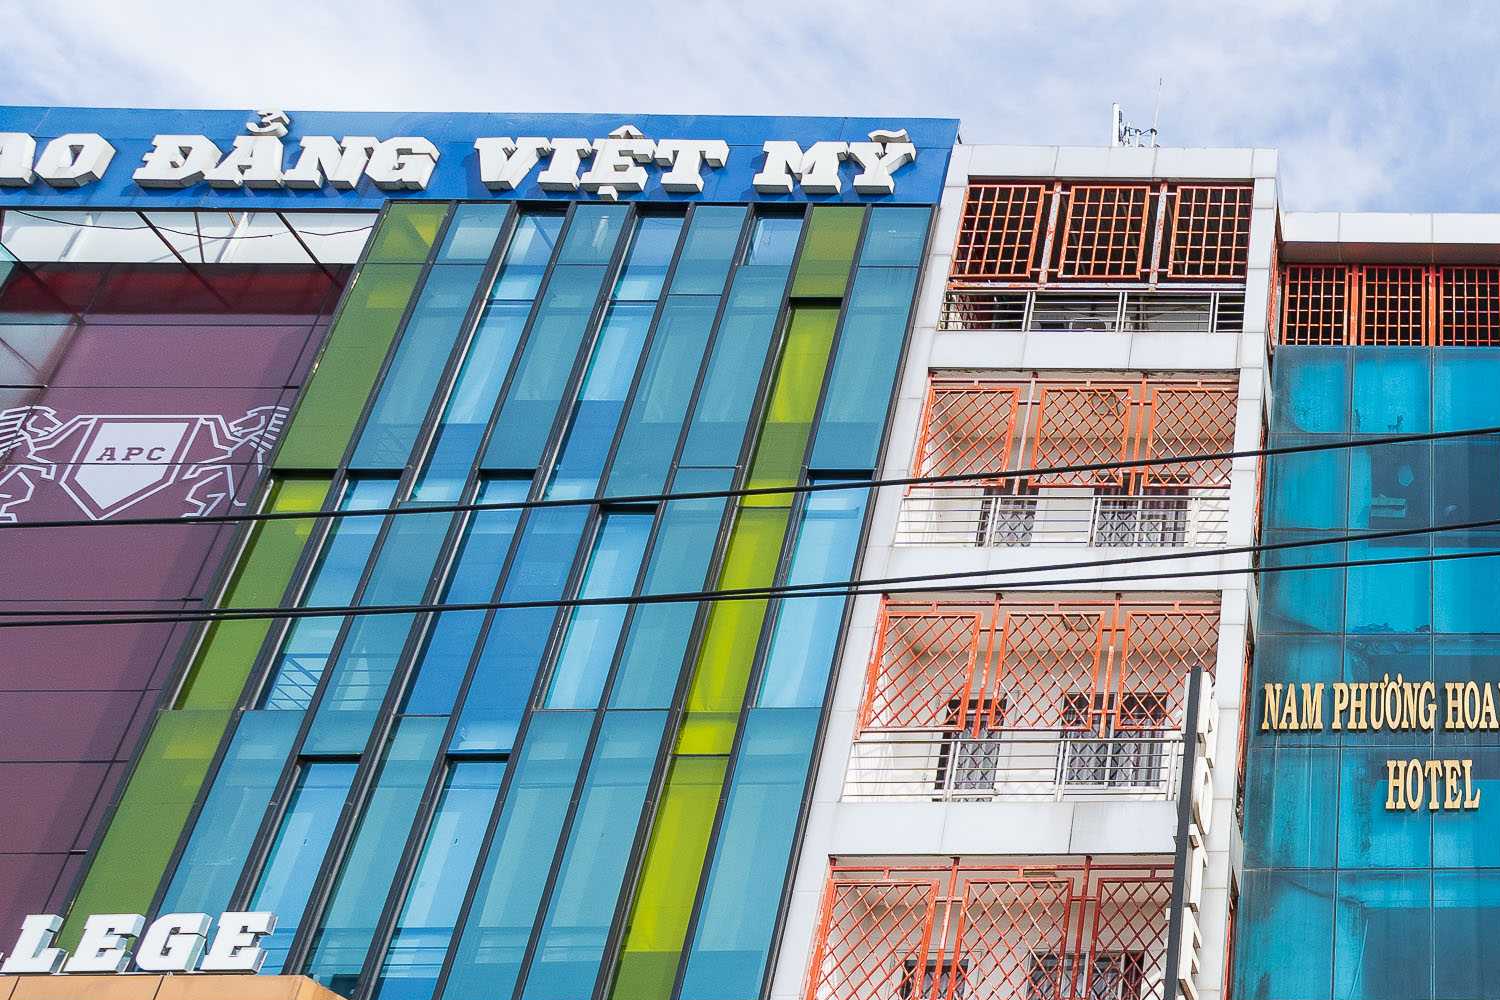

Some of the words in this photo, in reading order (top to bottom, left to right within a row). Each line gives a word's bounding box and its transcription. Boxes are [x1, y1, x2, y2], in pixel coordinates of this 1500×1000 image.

[132, 110, 441, 191] ĐẢNG
[474, 124, 730, 202] VIỆT
[752, 128, 917, 195] MỸ
[96, 447, 166, 461] APC
[1261, 682, 1325, 731] NAM
[1331, 673, 1437, 731] PHƯƠNG
[1385, 759, 1481, 812] HOTEL
